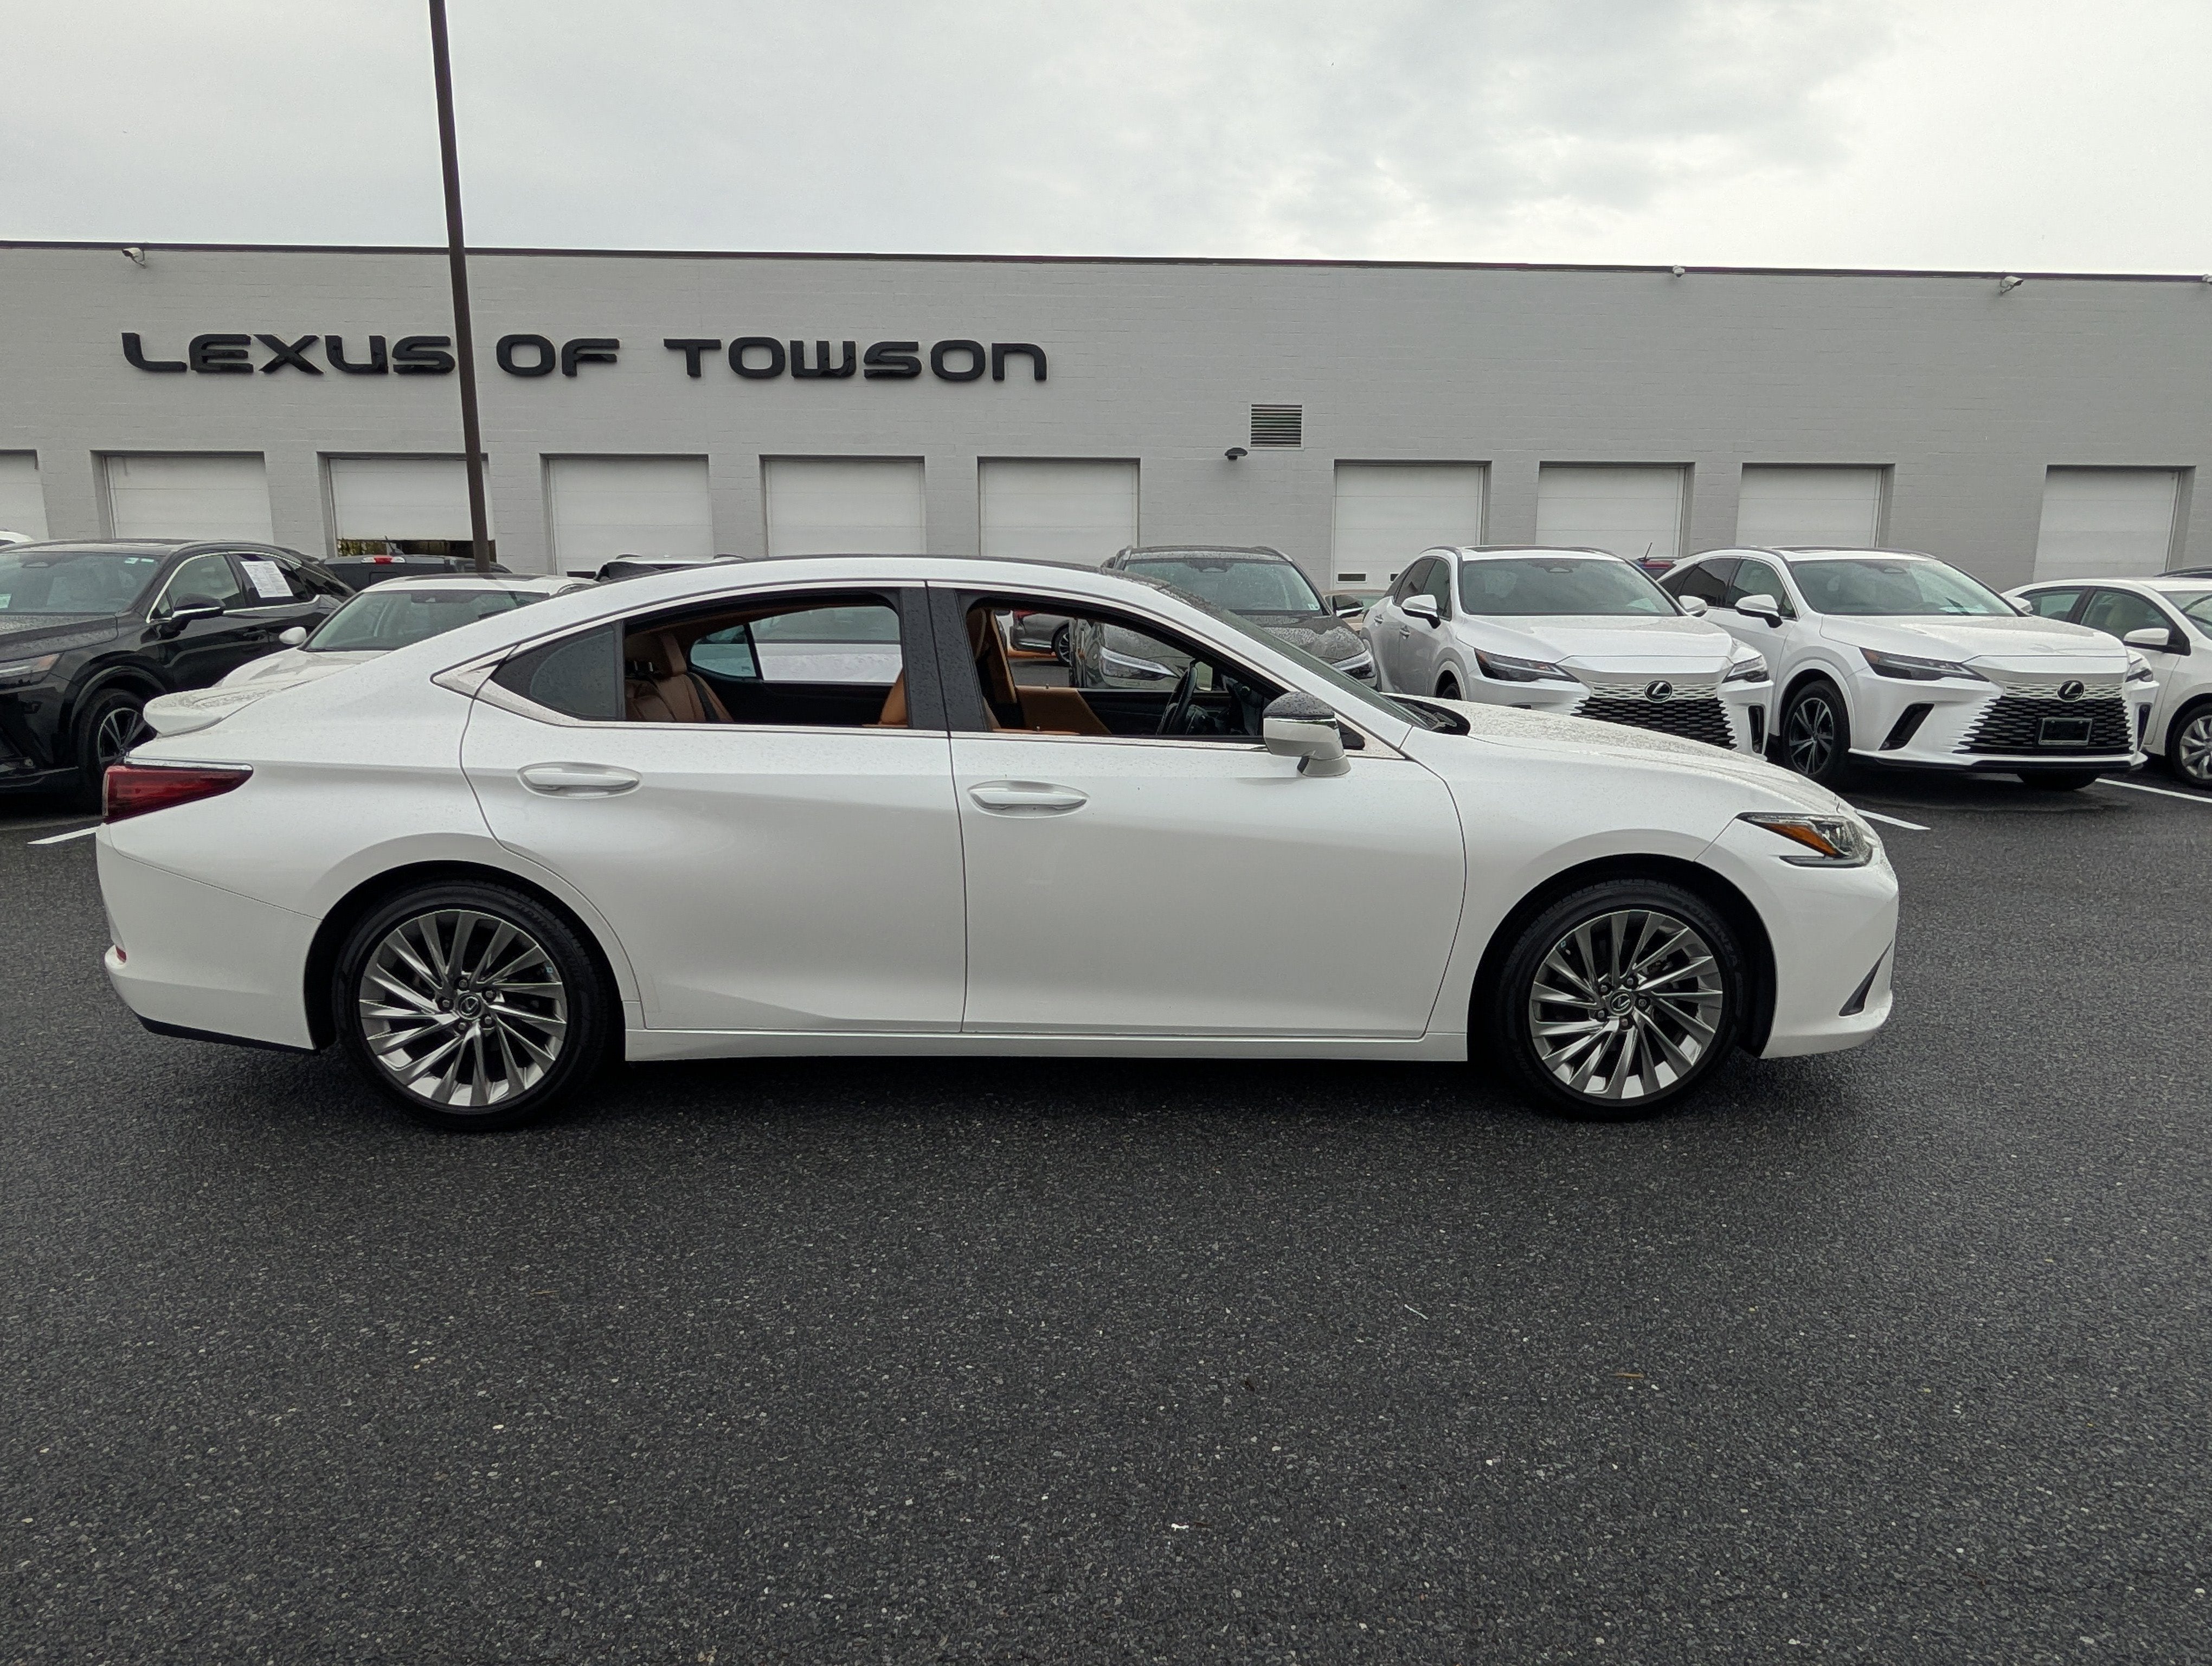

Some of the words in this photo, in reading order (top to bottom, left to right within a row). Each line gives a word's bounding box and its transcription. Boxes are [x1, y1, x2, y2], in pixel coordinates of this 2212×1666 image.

[122, 332, 455, 376] LEXUS
[496, 334, 620, 379] OF
[664, 337, 1047, 383] TOWSON
